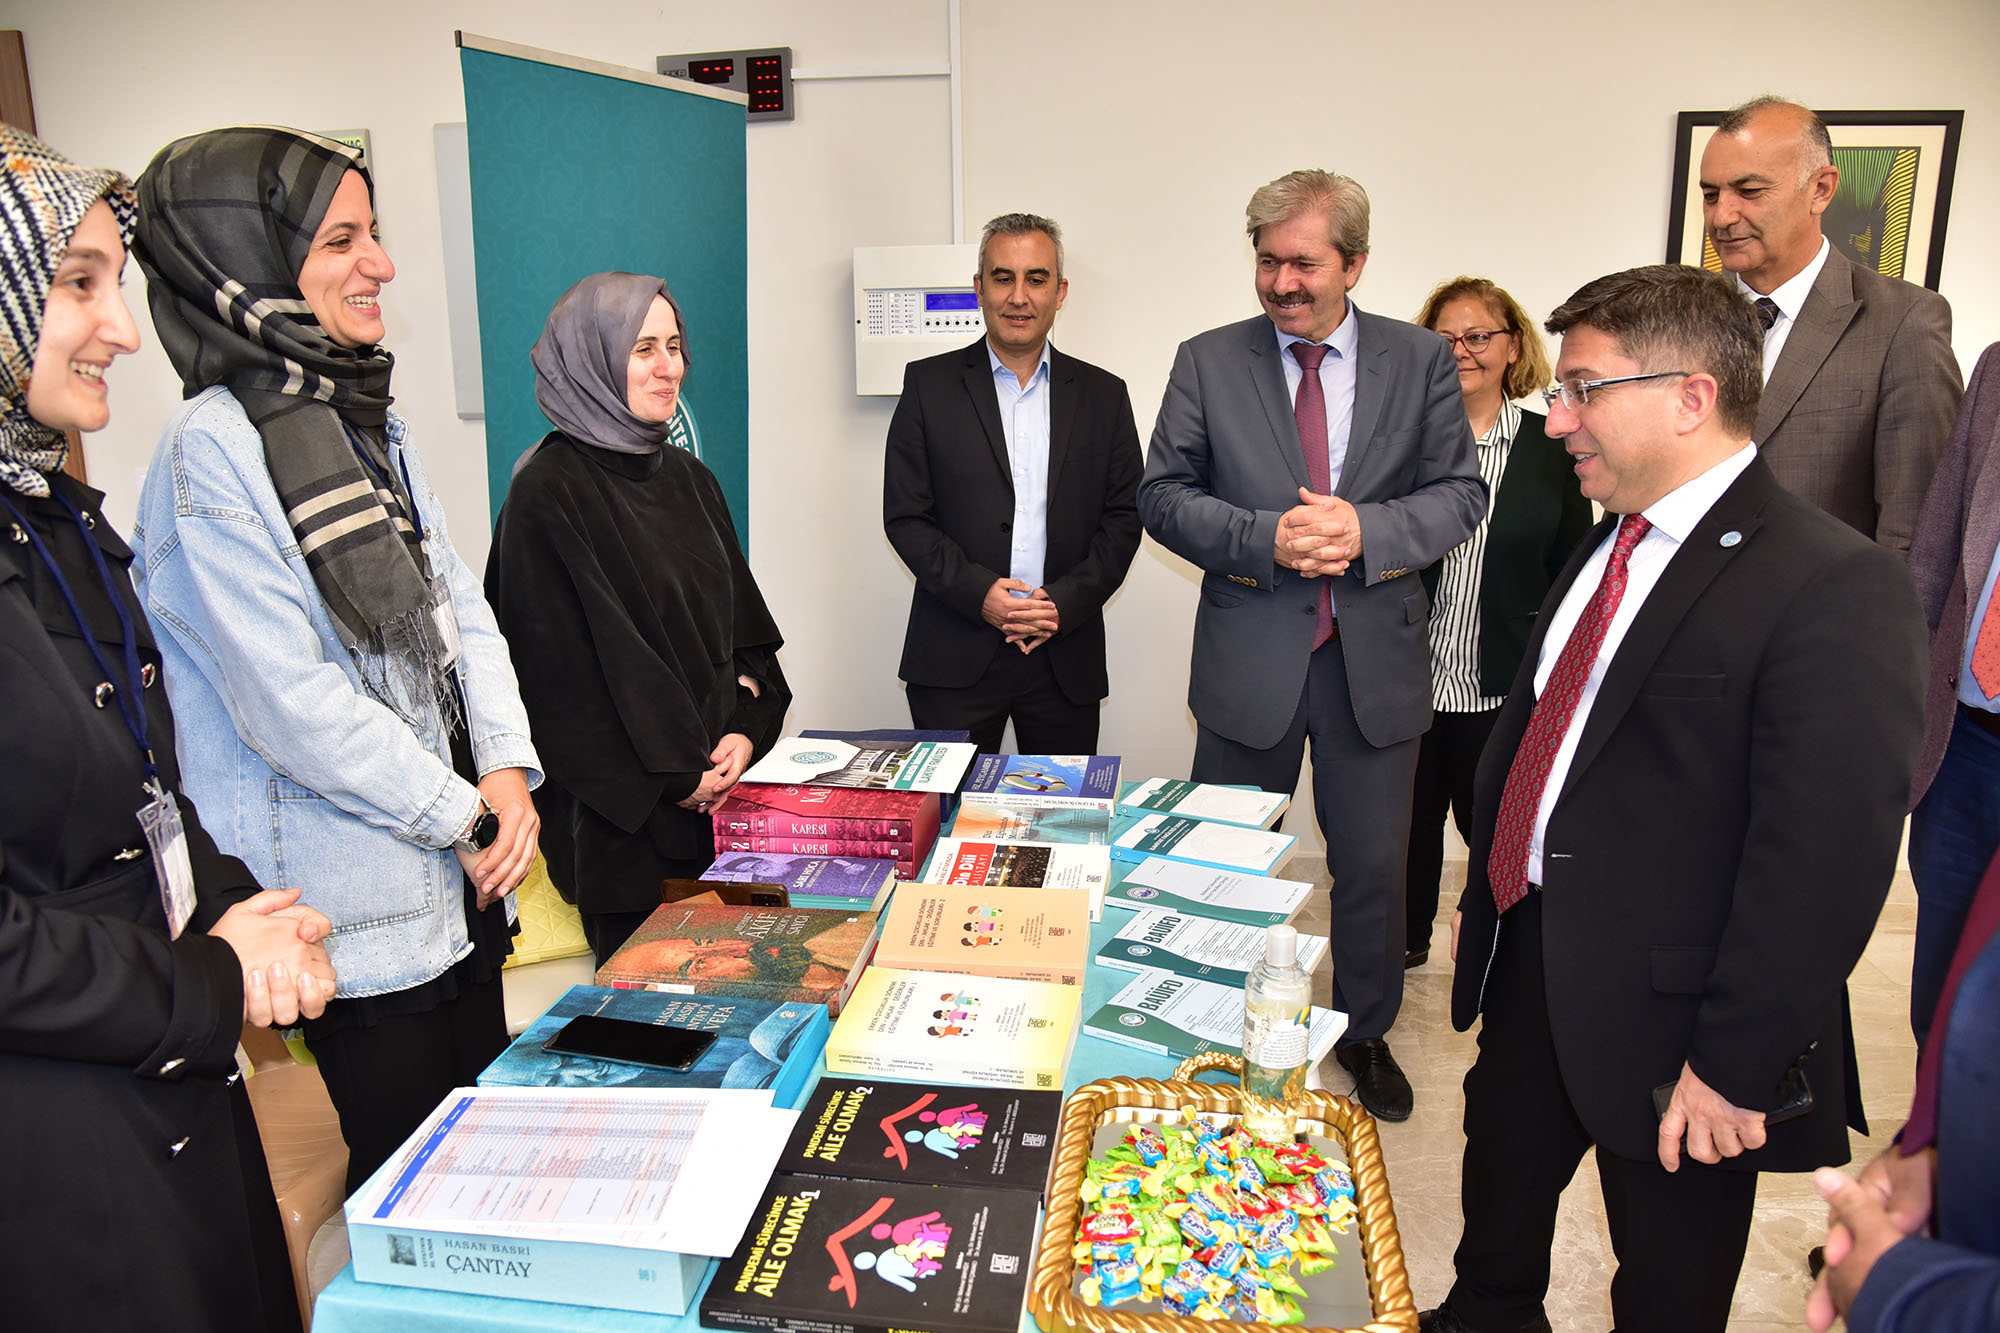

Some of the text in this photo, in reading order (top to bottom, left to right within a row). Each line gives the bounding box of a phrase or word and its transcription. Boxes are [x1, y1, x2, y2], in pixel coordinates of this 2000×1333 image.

[791, 823, 827, 836] KARESİ
[951, 854, 978, 886] Din Dili
[786, 914, 810, 935] SAYGI
[1142, 915, 1182, 944] BAÜİFD
[1137, 979, 1184, 1011] BAÜİFD
[652, 1000, 683, 1026] HASAN
[686, 1004, 716, 1030] NTAY'A
[702, 1005, 737, 1030] VEFA
[855, 1086, 874, 1095] 2
[803, 1090, 845, 1158] PANDEMİ SÜRECİNDE
[832, 1090, 867, 1133] OLMAK
[818, 1133, 847, 1162] AİLE
[444, 1239, 532, 1256] HASAN BASRİ
[734, 1246, 766, 1293] PANDEMİ
[756, 1195, 787, 1247] SÜRECİNDE
[753, 1189, 821, 1298] AİLE OLMAK 1
[446, 1254, 533, 1279] ÇANTAY
